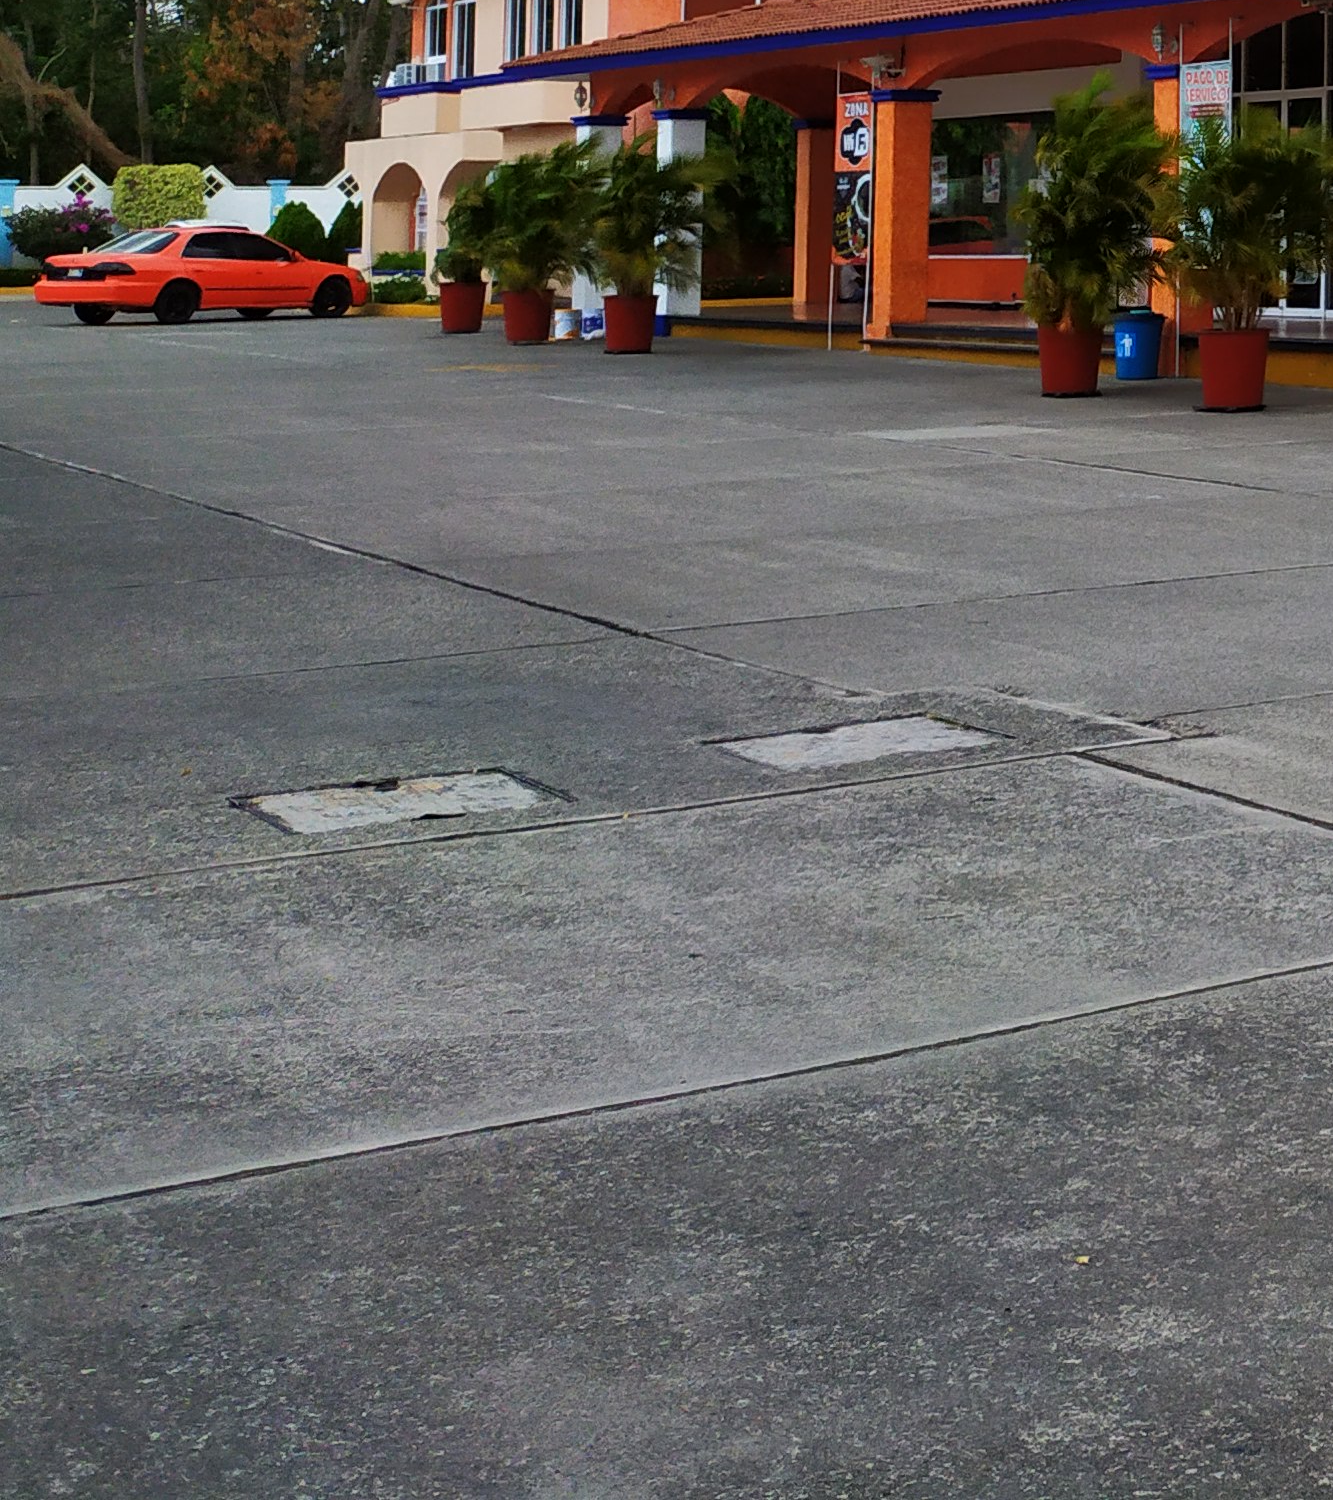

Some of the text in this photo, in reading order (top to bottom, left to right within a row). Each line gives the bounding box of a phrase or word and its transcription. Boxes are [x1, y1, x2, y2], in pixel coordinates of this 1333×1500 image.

[1186, 69, 1229, 85] PAGO DE
[845, 102, 869, 117] ZONA
